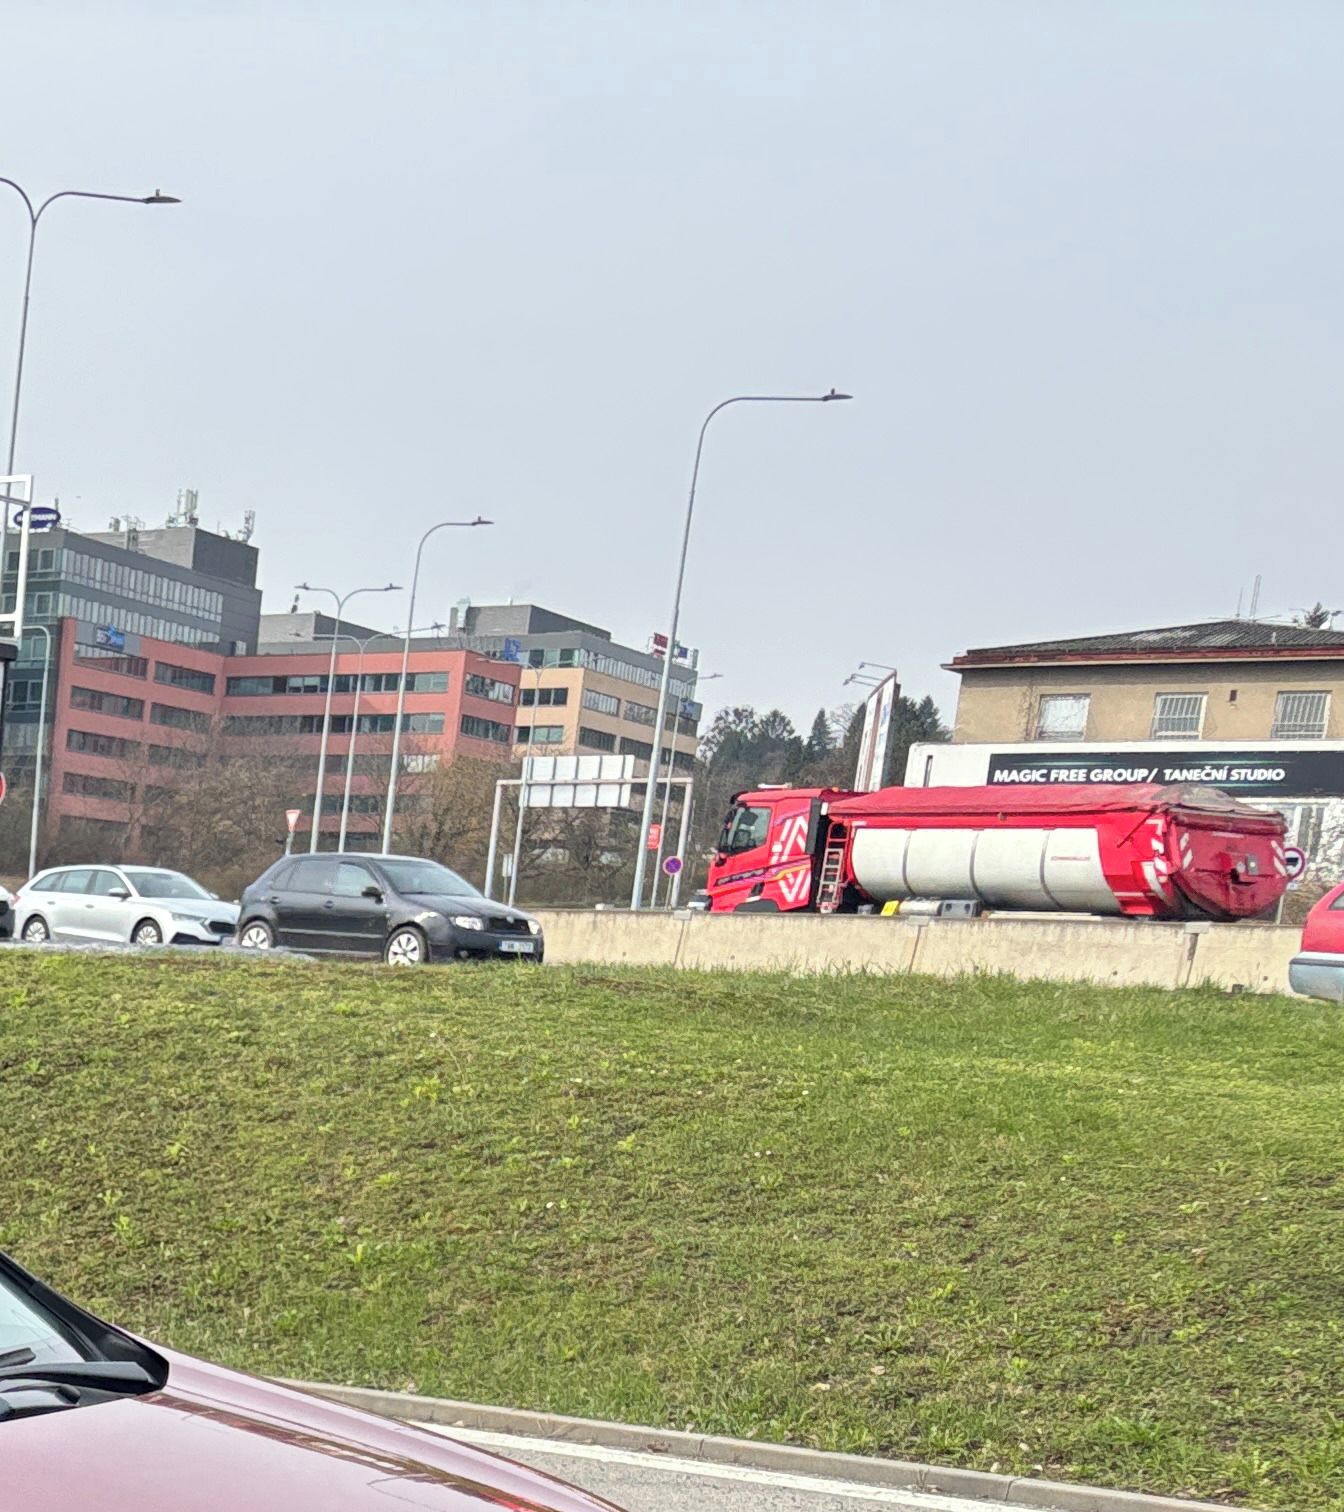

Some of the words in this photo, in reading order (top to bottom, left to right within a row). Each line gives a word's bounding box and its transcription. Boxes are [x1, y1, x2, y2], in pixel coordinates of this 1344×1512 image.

[993, 768, 1049, 783] MAGIC
[1050, 768, 1088, 782] FREE
[1089, 766, 1157, 783] GROUP/
[1163, 765, 1228, 782] TANEČNÍ
[1230, 768, 1286, 781] STUDIO
